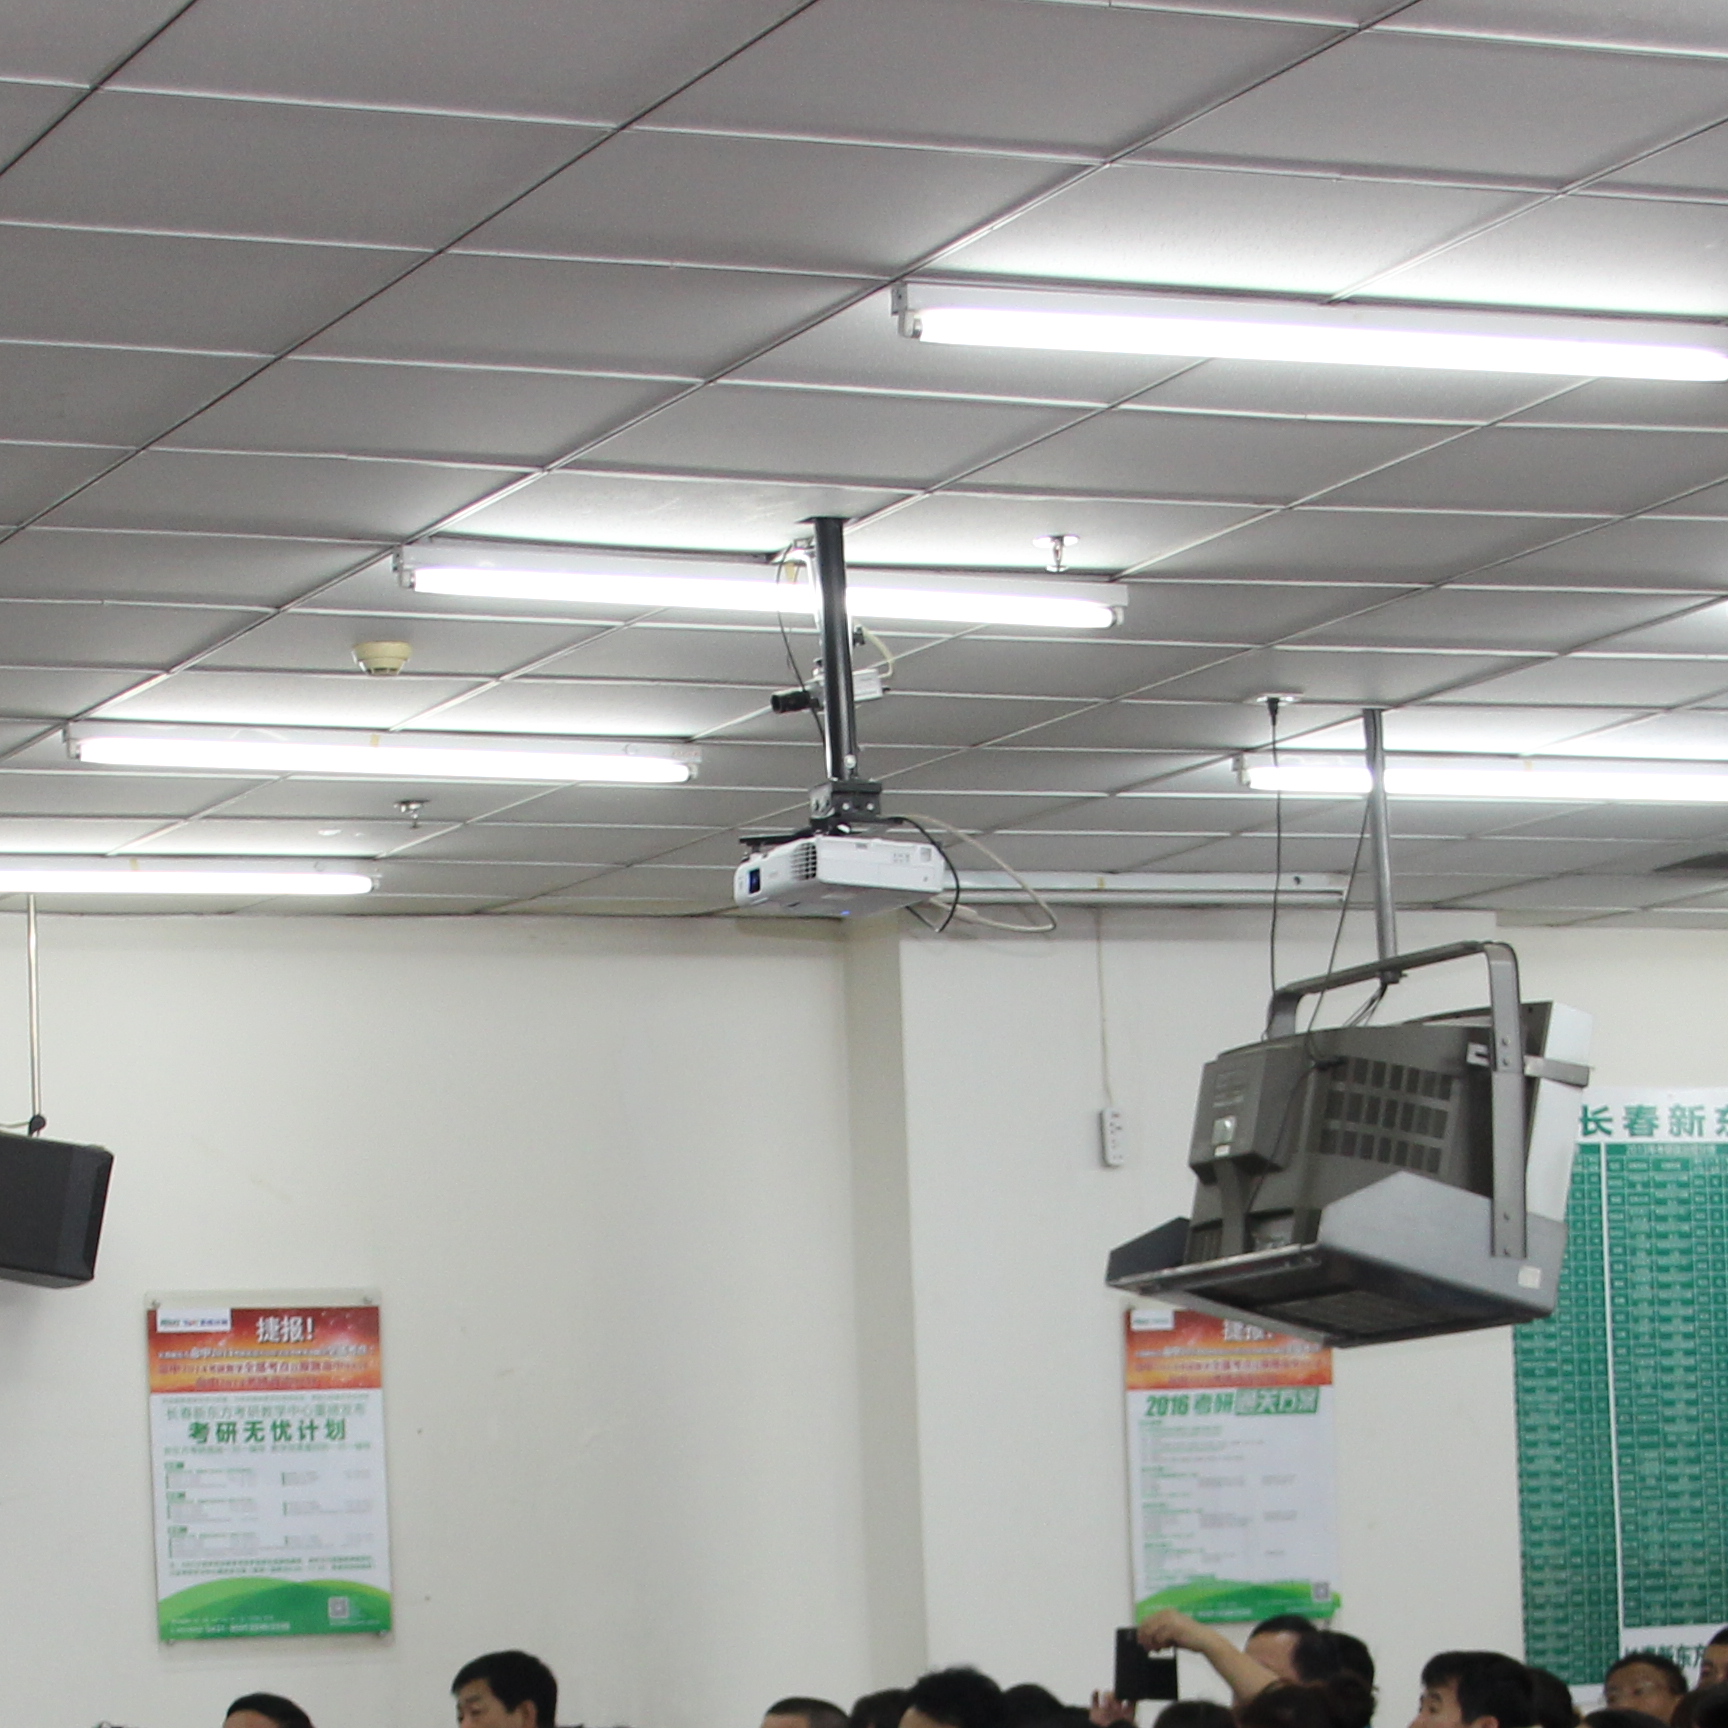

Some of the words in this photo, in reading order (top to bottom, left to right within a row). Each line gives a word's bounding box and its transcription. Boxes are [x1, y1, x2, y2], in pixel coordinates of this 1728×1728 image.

[257, 1315, 315, 1343] 捷报!
[189, 1417, 347, 1444] 考研无忧计划
